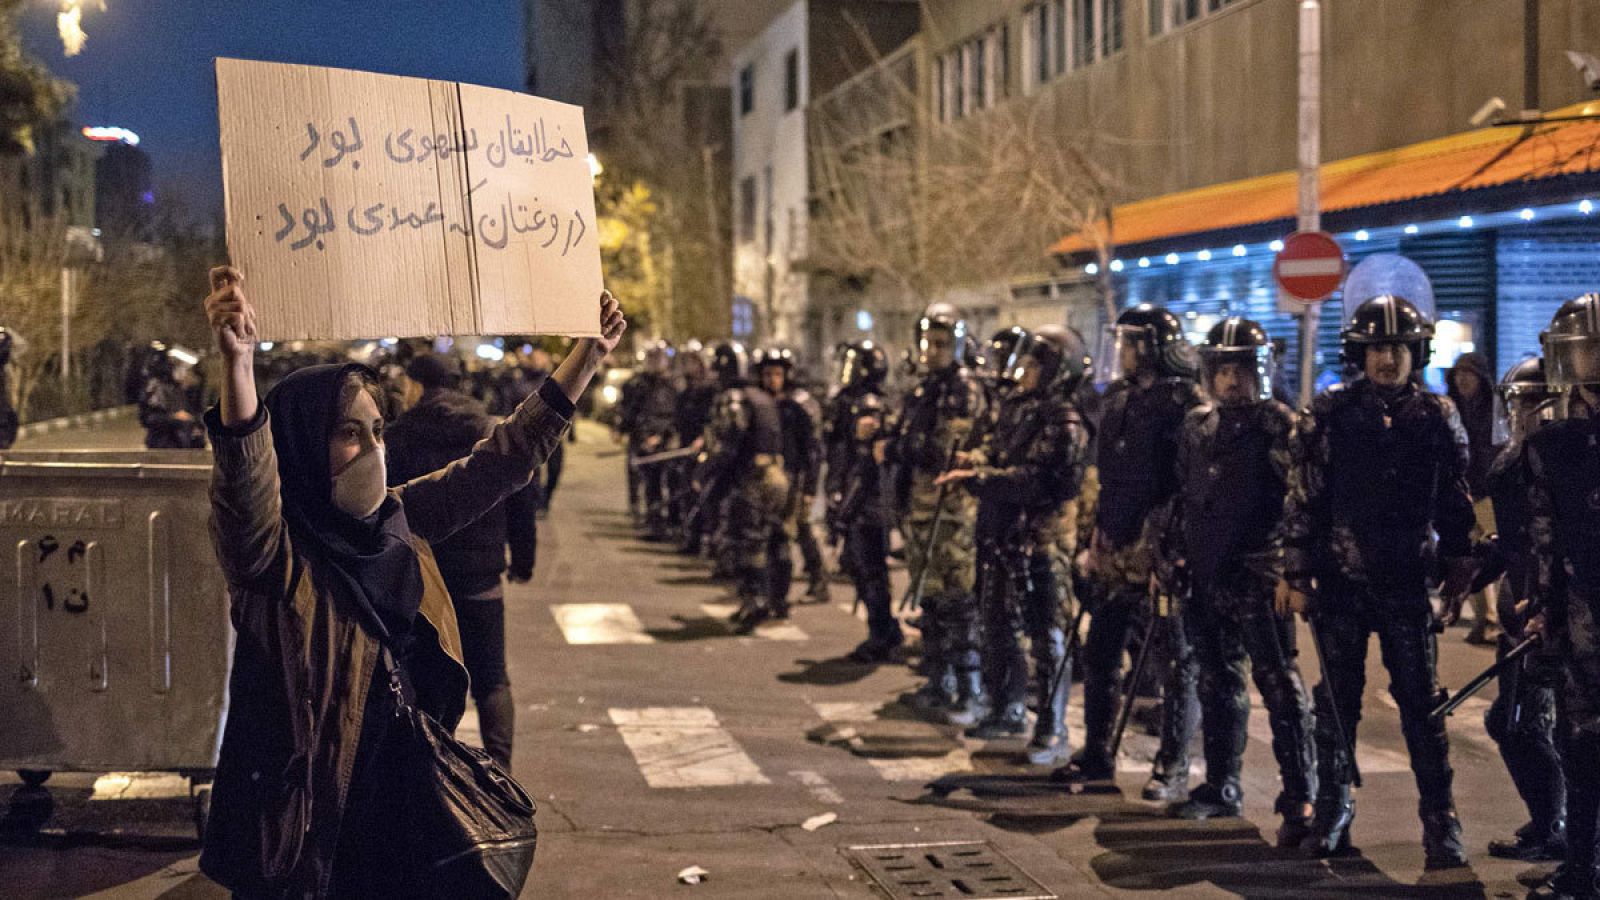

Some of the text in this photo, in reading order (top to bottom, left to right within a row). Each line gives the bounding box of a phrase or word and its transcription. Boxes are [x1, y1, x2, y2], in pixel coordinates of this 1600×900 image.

[299, 116, 363, 170] بود
[385, 128, 478, 163] سهوی
[274, 197, 336, 250] بود
[347, 202, 445, 235] عمدی
[478, 191, 586, 256] دروغتان
